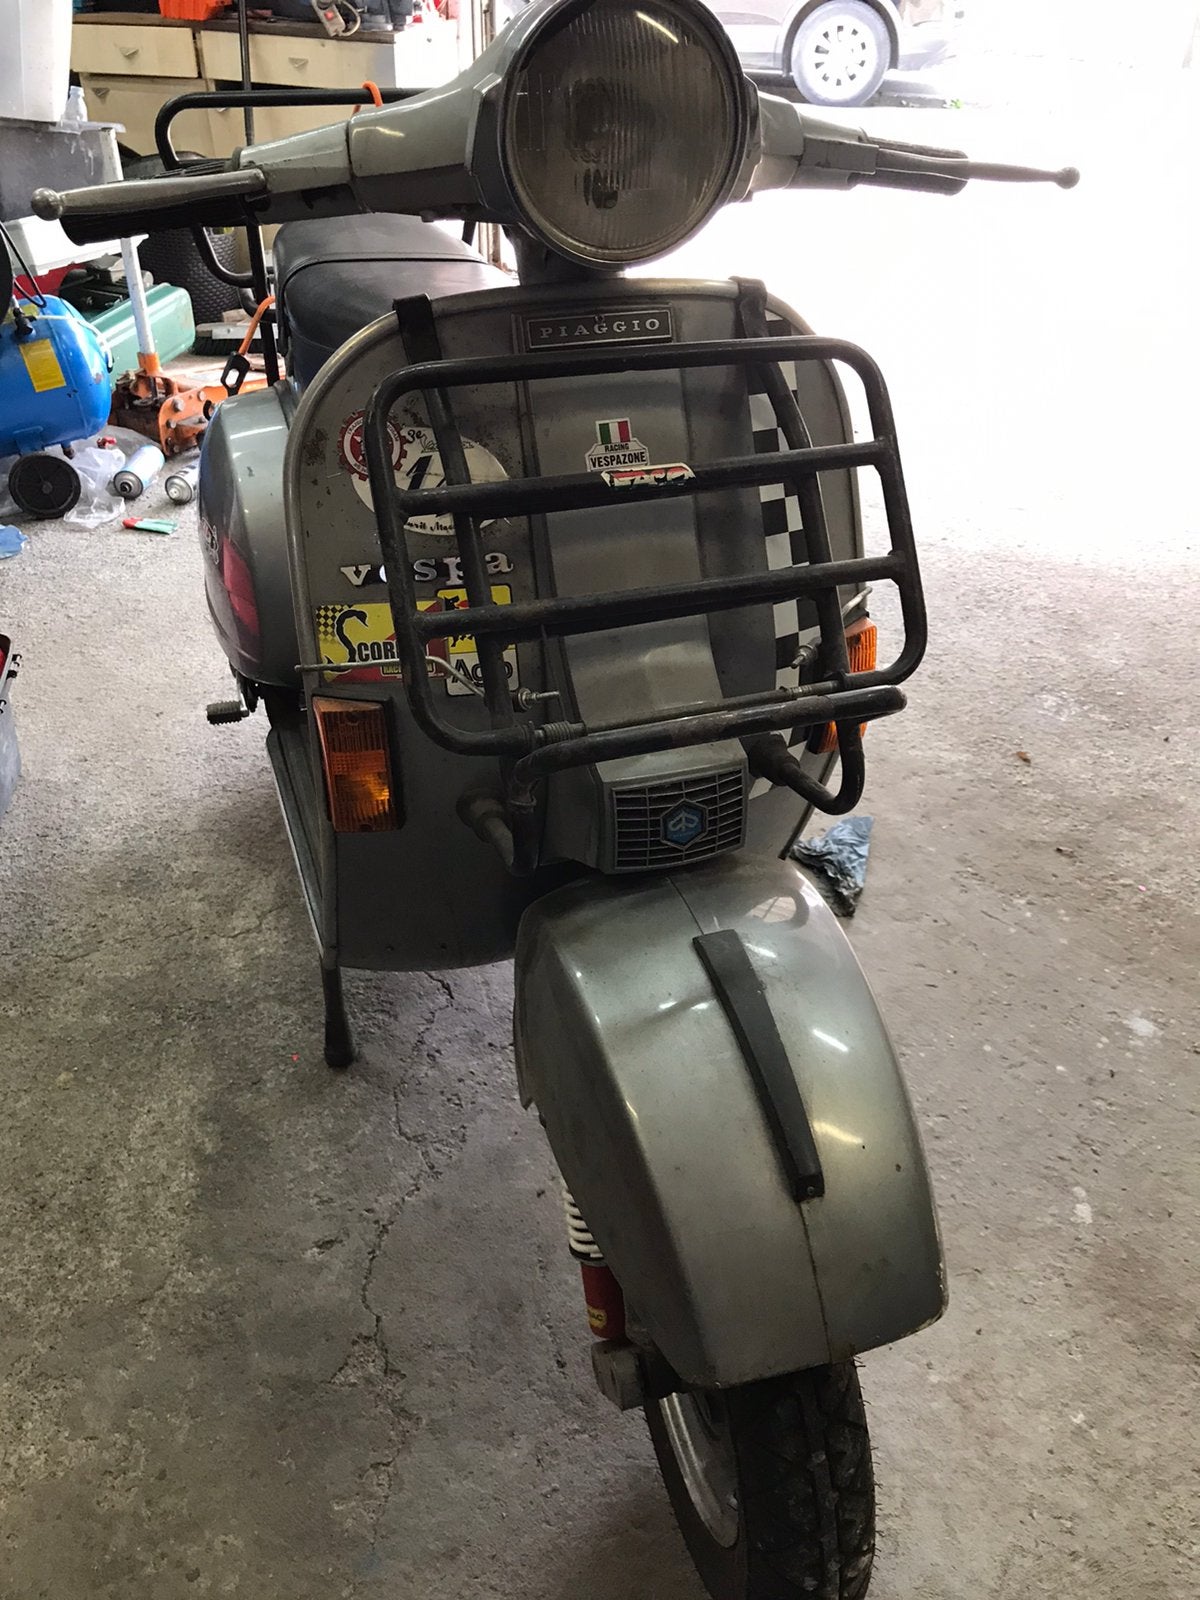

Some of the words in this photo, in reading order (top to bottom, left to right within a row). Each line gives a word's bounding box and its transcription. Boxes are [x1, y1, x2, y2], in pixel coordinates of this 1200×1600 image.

[539, 318, 660, 339] PIAGGIO
[604, 443, 630, 453] RACING
[590, 451, 647, 469] VESPAZONE
[340, 552, 514, 586] vspa
